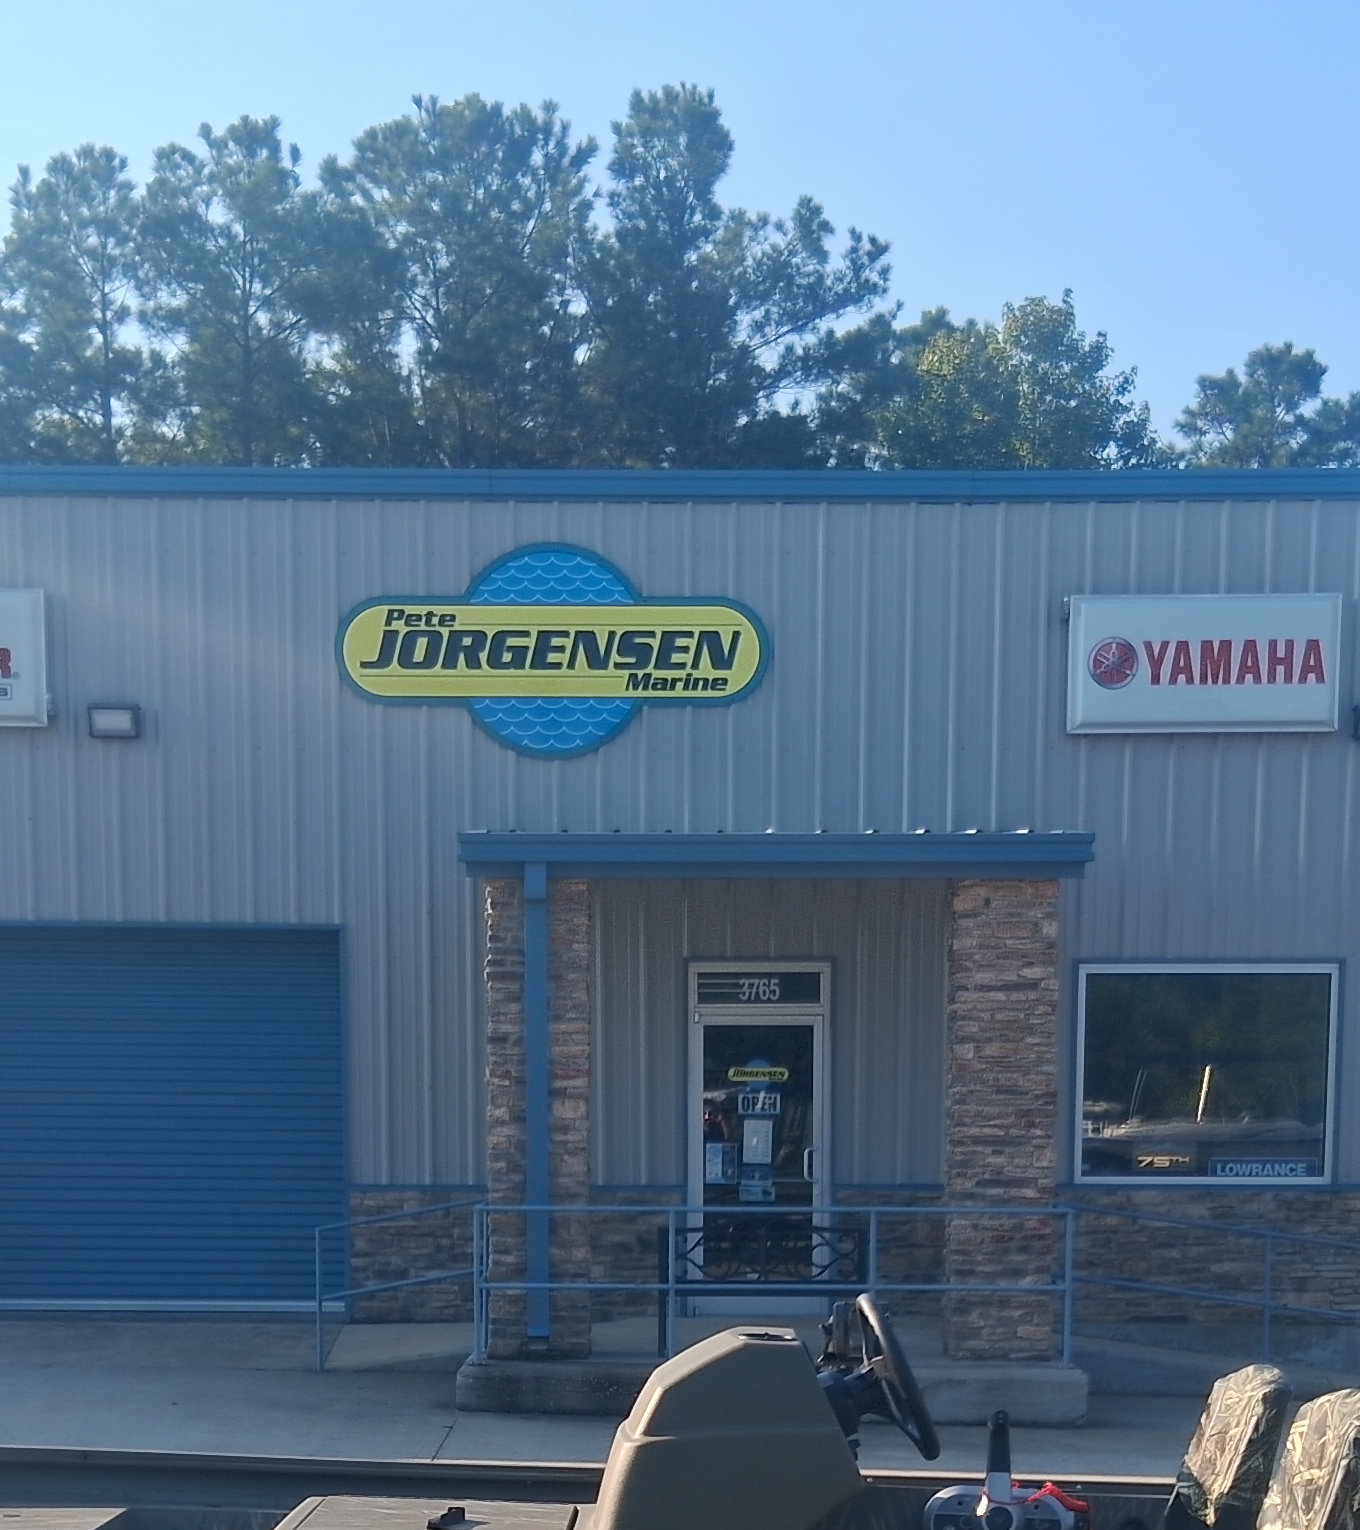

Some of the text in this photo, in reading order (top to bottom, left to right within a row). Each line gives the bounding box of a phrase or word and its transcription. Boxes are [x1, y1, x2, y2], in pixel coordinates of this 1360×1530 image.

[384, 609, 457, 628] Pete
[358, 629, 743, 671] JORGENSEN
[1143, 639, 1326, 685] YAMAHA
[624, 672, 728, 692] Marine
[739, 979, 779, 1000] 3765
[741, 1095, 777, 1112] OPEN
[1216, 1164, 1307, 1177] LOWRANCE
